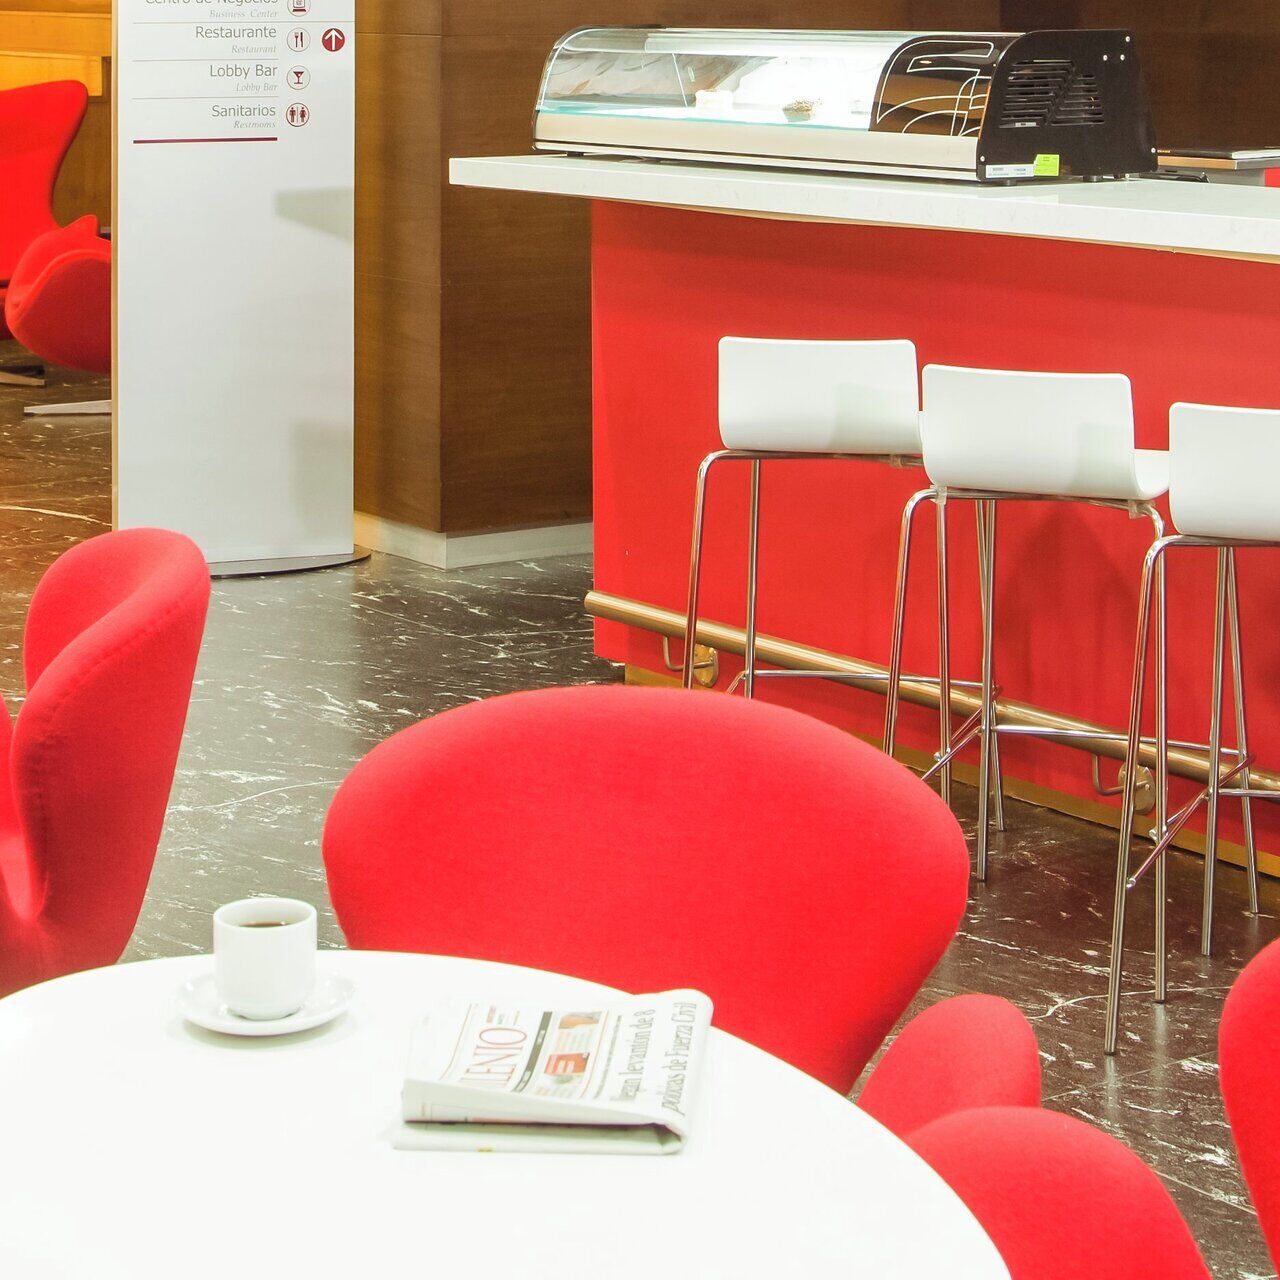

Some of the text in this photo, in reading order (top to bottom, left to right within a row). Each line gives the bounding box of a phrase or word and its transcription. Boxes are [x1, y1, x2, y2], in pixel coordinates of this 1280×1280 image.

[209, 8, 278, 19] Business Center
[195, 25, 277, 39] Restaurante
[231, 44, 277, 55] Restaurant
[209, 63, 278, 80] Lobby Bar
[235, 81, 278, 94] Lobby Bar
[211, 104, 277, 118] Sanitarios
[633, 1008, 657, 1017] 8
[661, 1058, 698, 1071] de
